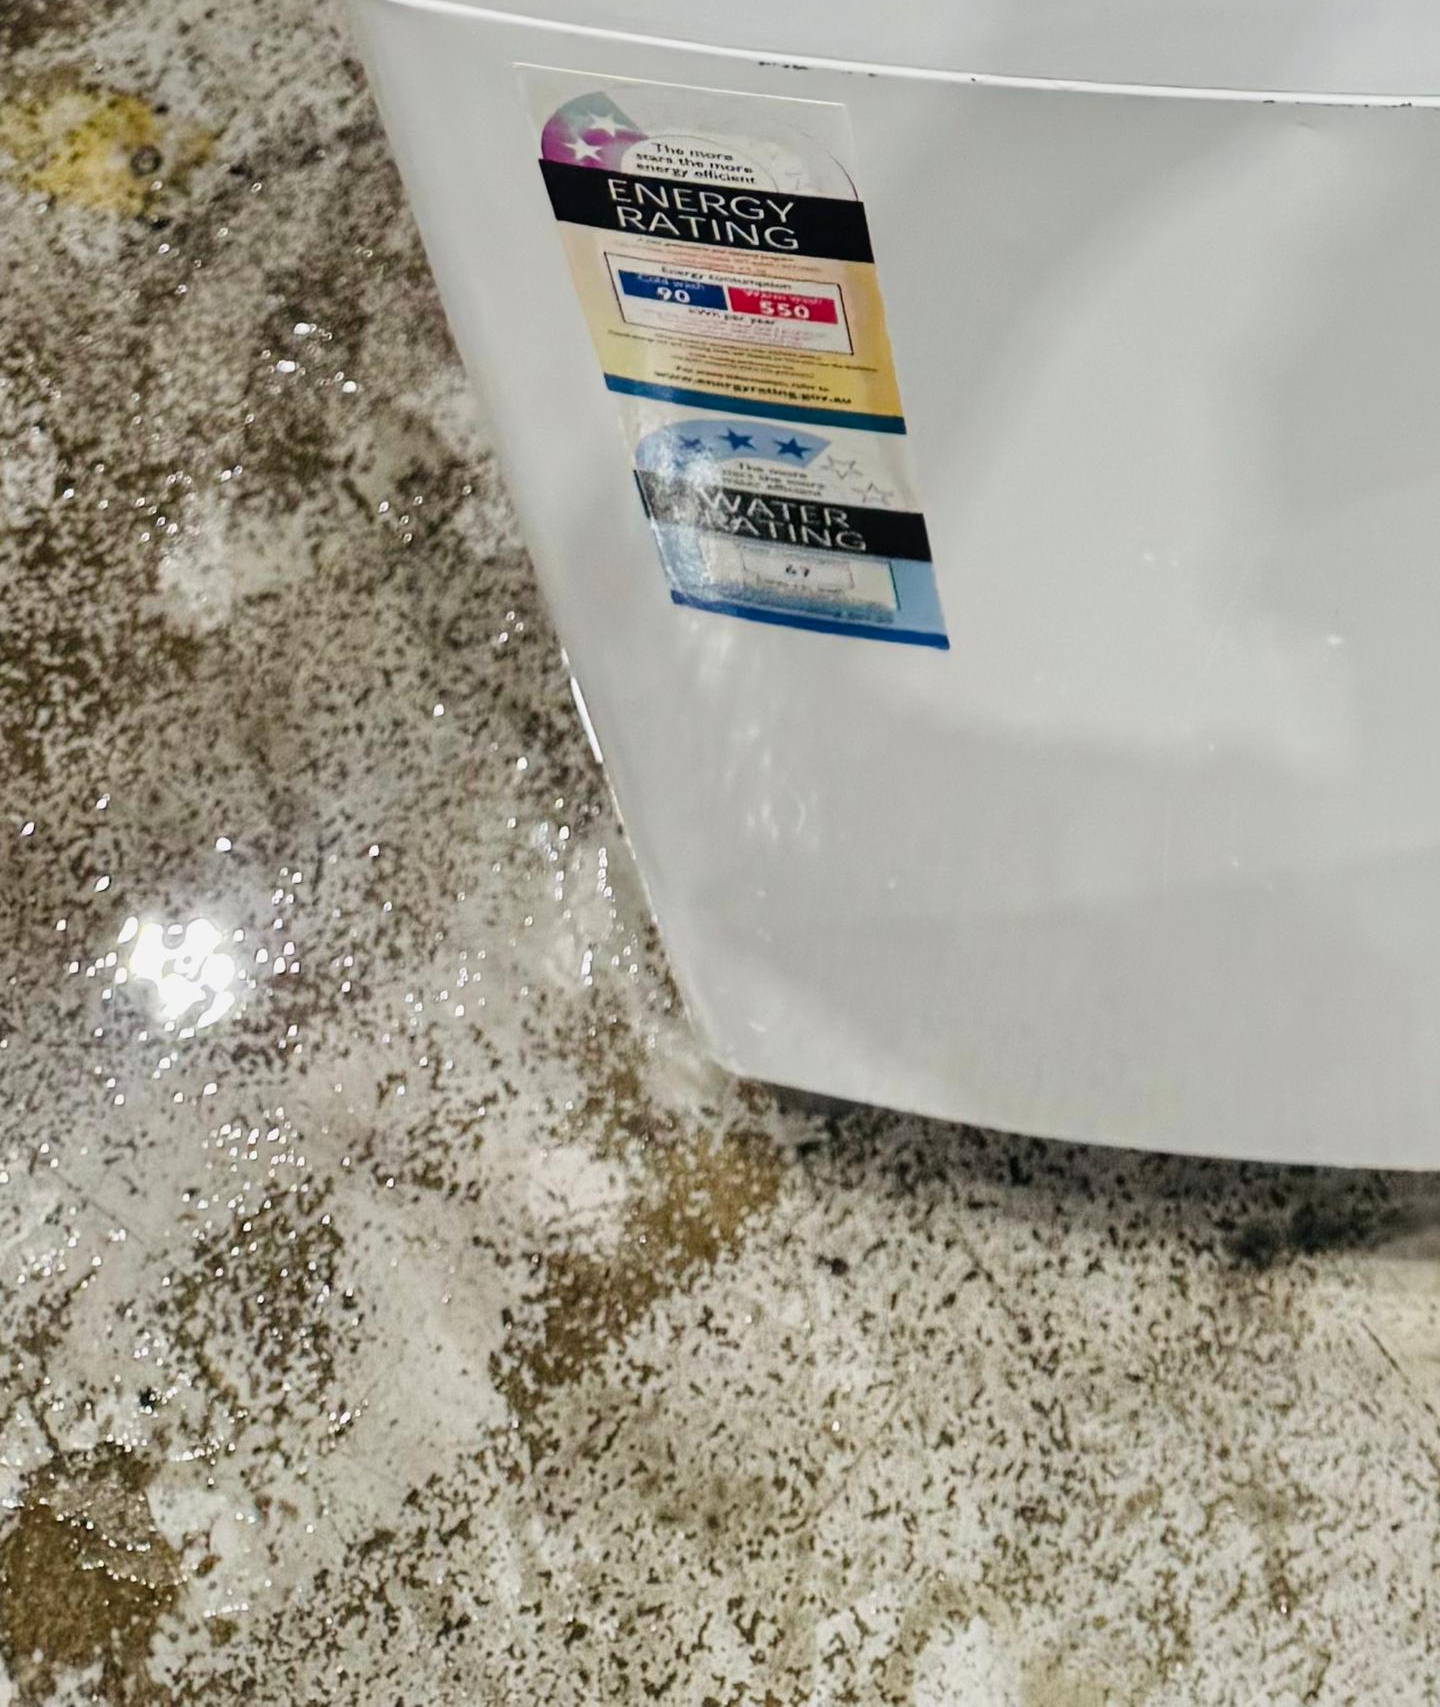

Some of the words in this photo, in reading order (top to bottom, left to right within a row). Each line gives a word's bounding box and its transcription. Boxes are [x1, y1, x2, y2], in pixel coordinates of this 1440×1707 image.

[607, 178, 795, 223] ENERGY
[616, 205, 800, 251] RATING
[758, 300, 811, 320] 550
[699, 487, 850, 529] WATER
[704, 507, 867, 551] RATING
